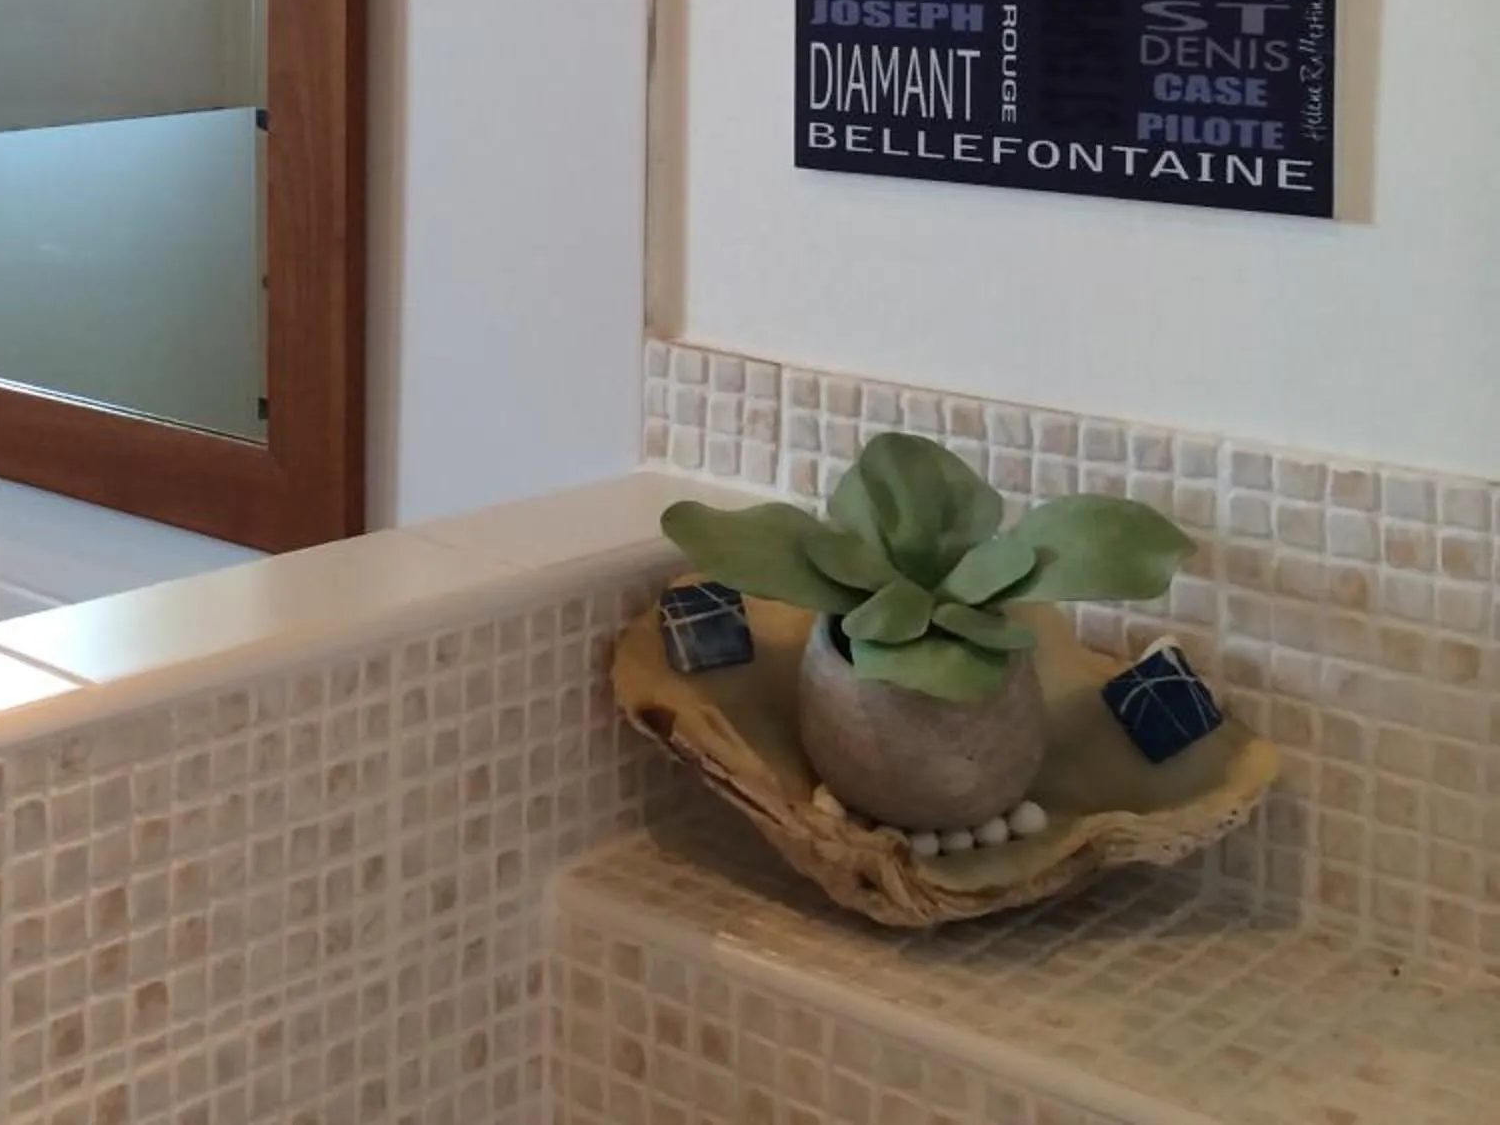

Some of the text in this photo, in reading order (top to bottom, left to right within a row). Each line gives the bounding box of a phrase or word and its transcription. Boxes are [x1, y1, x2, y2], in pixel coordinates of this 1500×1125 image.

[1141, 0, 1290, 35] ST
[1001, 4, 1018, 124] ROUGE
[1140, 36, 1289, 72] DENIS
[809, 42, 981, 122] DIAMANT
[1153, 73, 1268, 107] CASE
[1137, 112, 1285, 151] PILOTE
[808, 122, 1314, 191] BELLEFONTAINE
